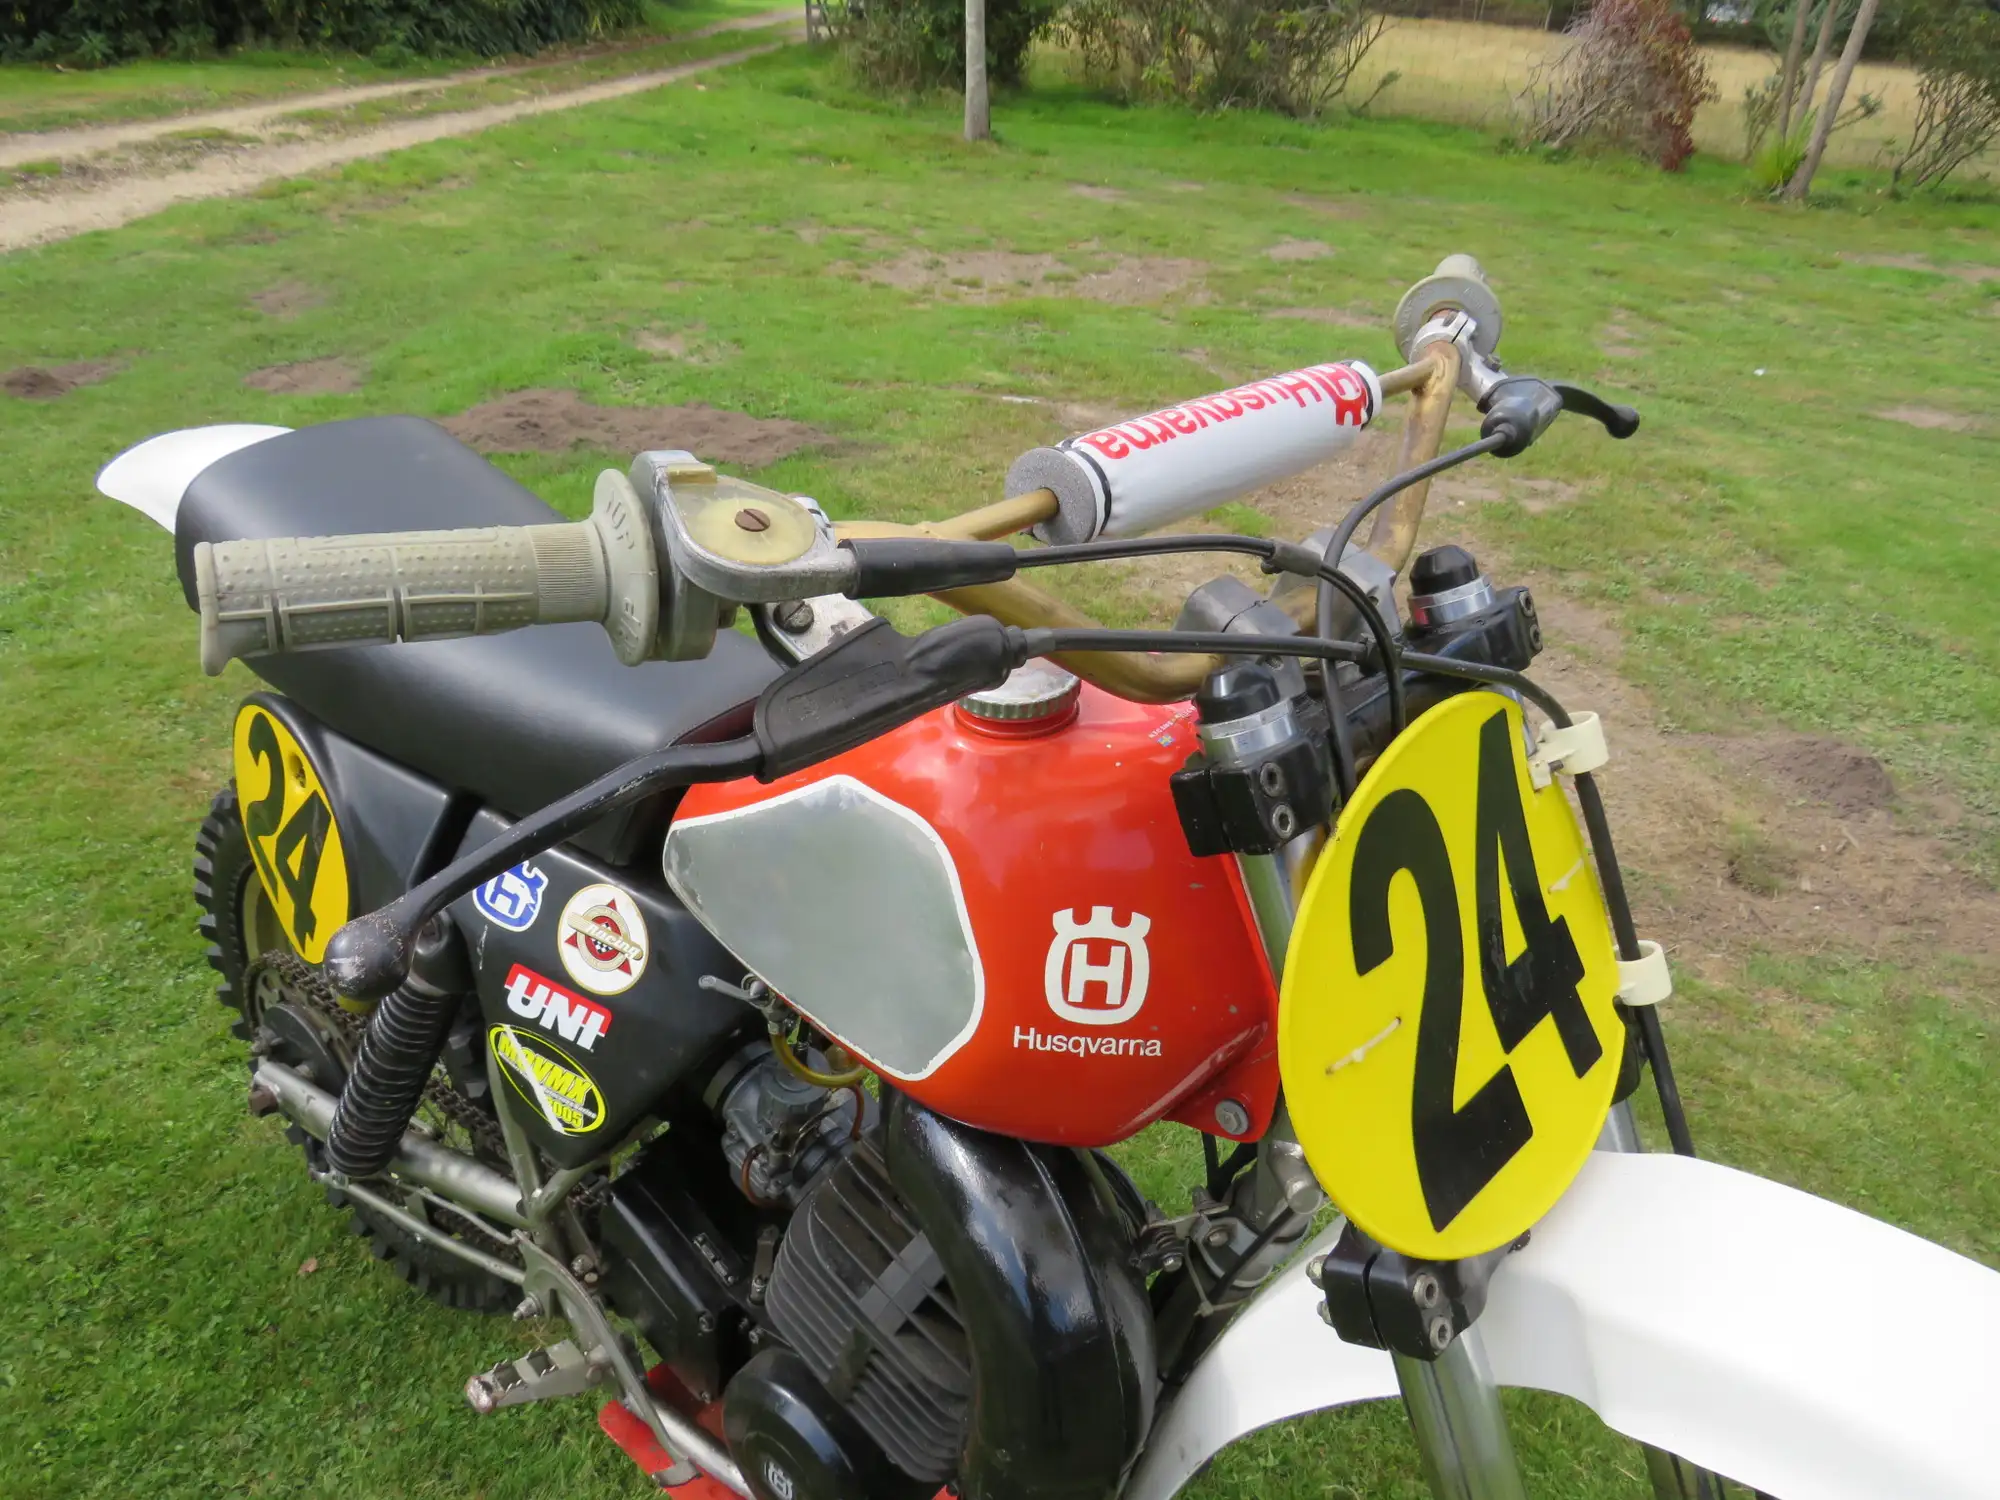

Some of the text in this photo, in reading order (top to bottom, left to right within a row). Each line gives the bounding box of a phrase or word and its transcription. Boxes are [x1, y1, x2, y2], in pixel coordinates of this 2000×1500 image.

[1080, 368, 1322, 460] Husqvarna
[247, 711, 332, 955] 24
[506, 973, 606, 1050] UNI
[1068, 943, 1126, 1005] H
[1349, 707, 1604, 1233] 24
[1013, 1025, 1162, 1058] Husqvarna
